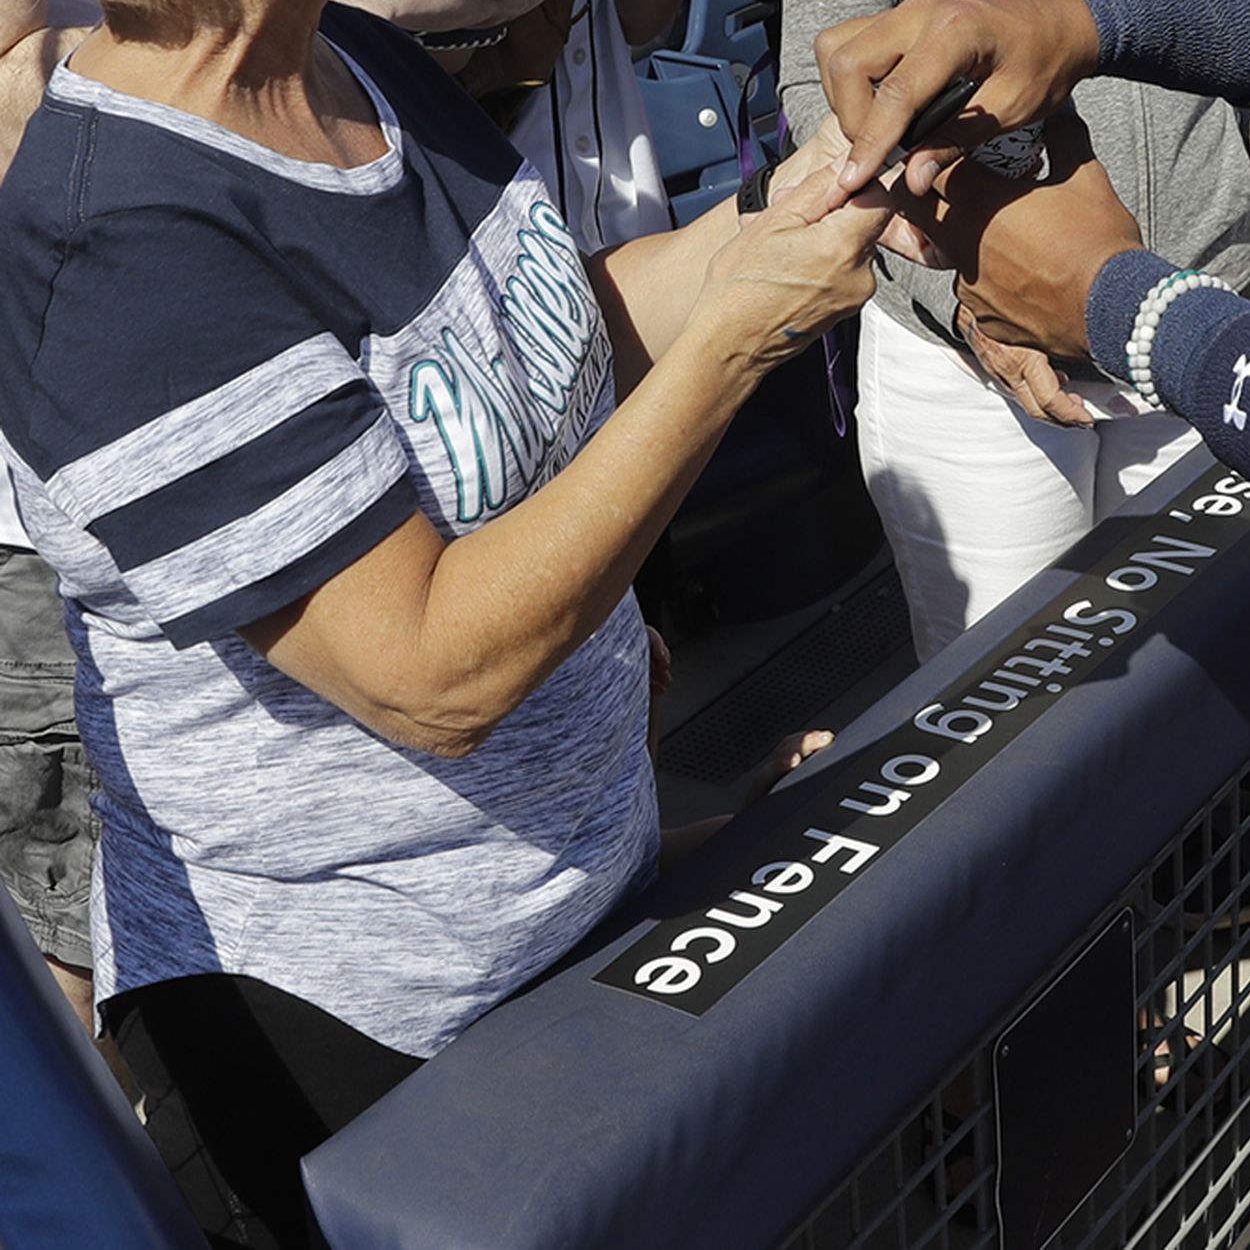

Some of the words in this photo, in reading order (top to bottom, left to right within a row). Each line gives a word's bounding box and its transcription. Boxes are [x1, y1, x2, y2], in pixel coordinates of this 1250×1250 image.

[1104, 534, 1217, 593] No
[915, 599, 1137, 743] Sitting
[838, 753, 942, 817] on
[634, 827, 880, 996] Fence
